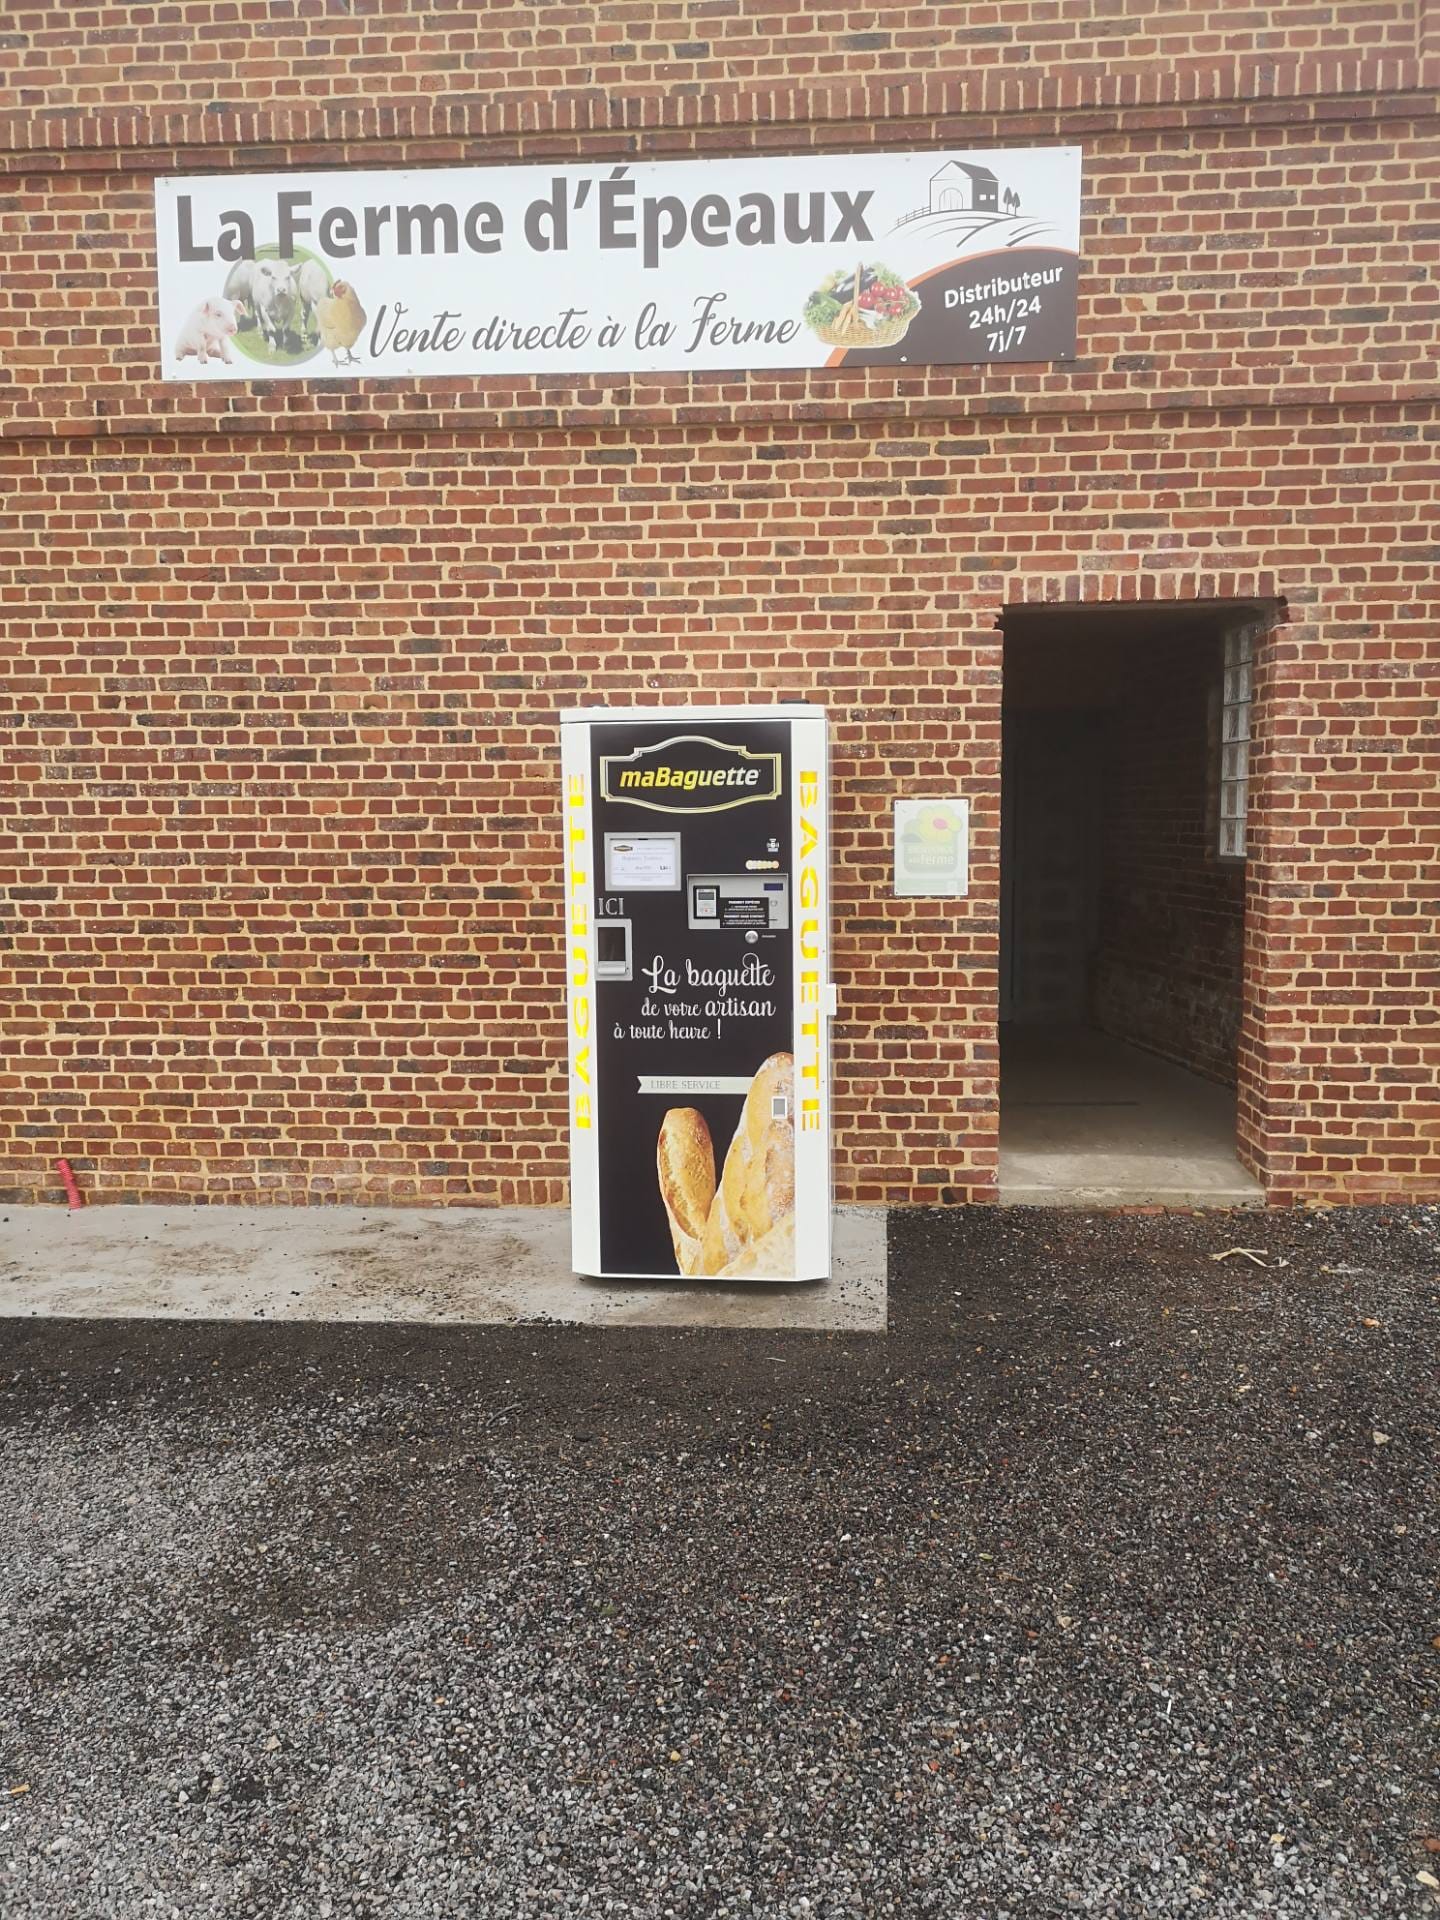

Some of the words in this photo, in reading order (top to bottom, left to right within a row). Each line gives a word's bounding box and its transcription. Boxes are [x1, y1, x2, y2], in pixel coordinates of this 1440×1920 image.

[177, 194, 256, 262] La
[277, 190, 504, 258] Ferme
[523, 166, 875, 268] d'Épeaux
[944, 266, 1064, 309] Distributeur
[369, 302, 465, 357] Vente
[472, 308, 592, 351] directe
[598, 313, 626, 348] à
[634, 302, 676, 348] la
[685, 292, 801, 353] Ferme
[969, 295, 1042, 329] 24h/24
[986, 325, 1027, 353] 7j/7
[619, 767, 760, 791] maBaguette
[598, 897, 625, 916] ICI
[569, 773, 592, 1129] BAGUETTE
[799, 770, 821, 1131] BAGUETTE
[641, 955, 681, 994] La
[685, 952, 776, 997] baguette
[641, 997, 660, 1017] de
[664, 1001, 702, 1017] votre
[705, 997, 777, 1017] artisan
[613, 1022, 625, 1039] à
[629, 1024, 666, 1040] toute
[668, 1019, 711, 1040] heure
[717, 1018, 722, 1040] !
[650, 1080, 679, 1089] LIBRE
[681, 1080, 721, 1090] SERVICE
